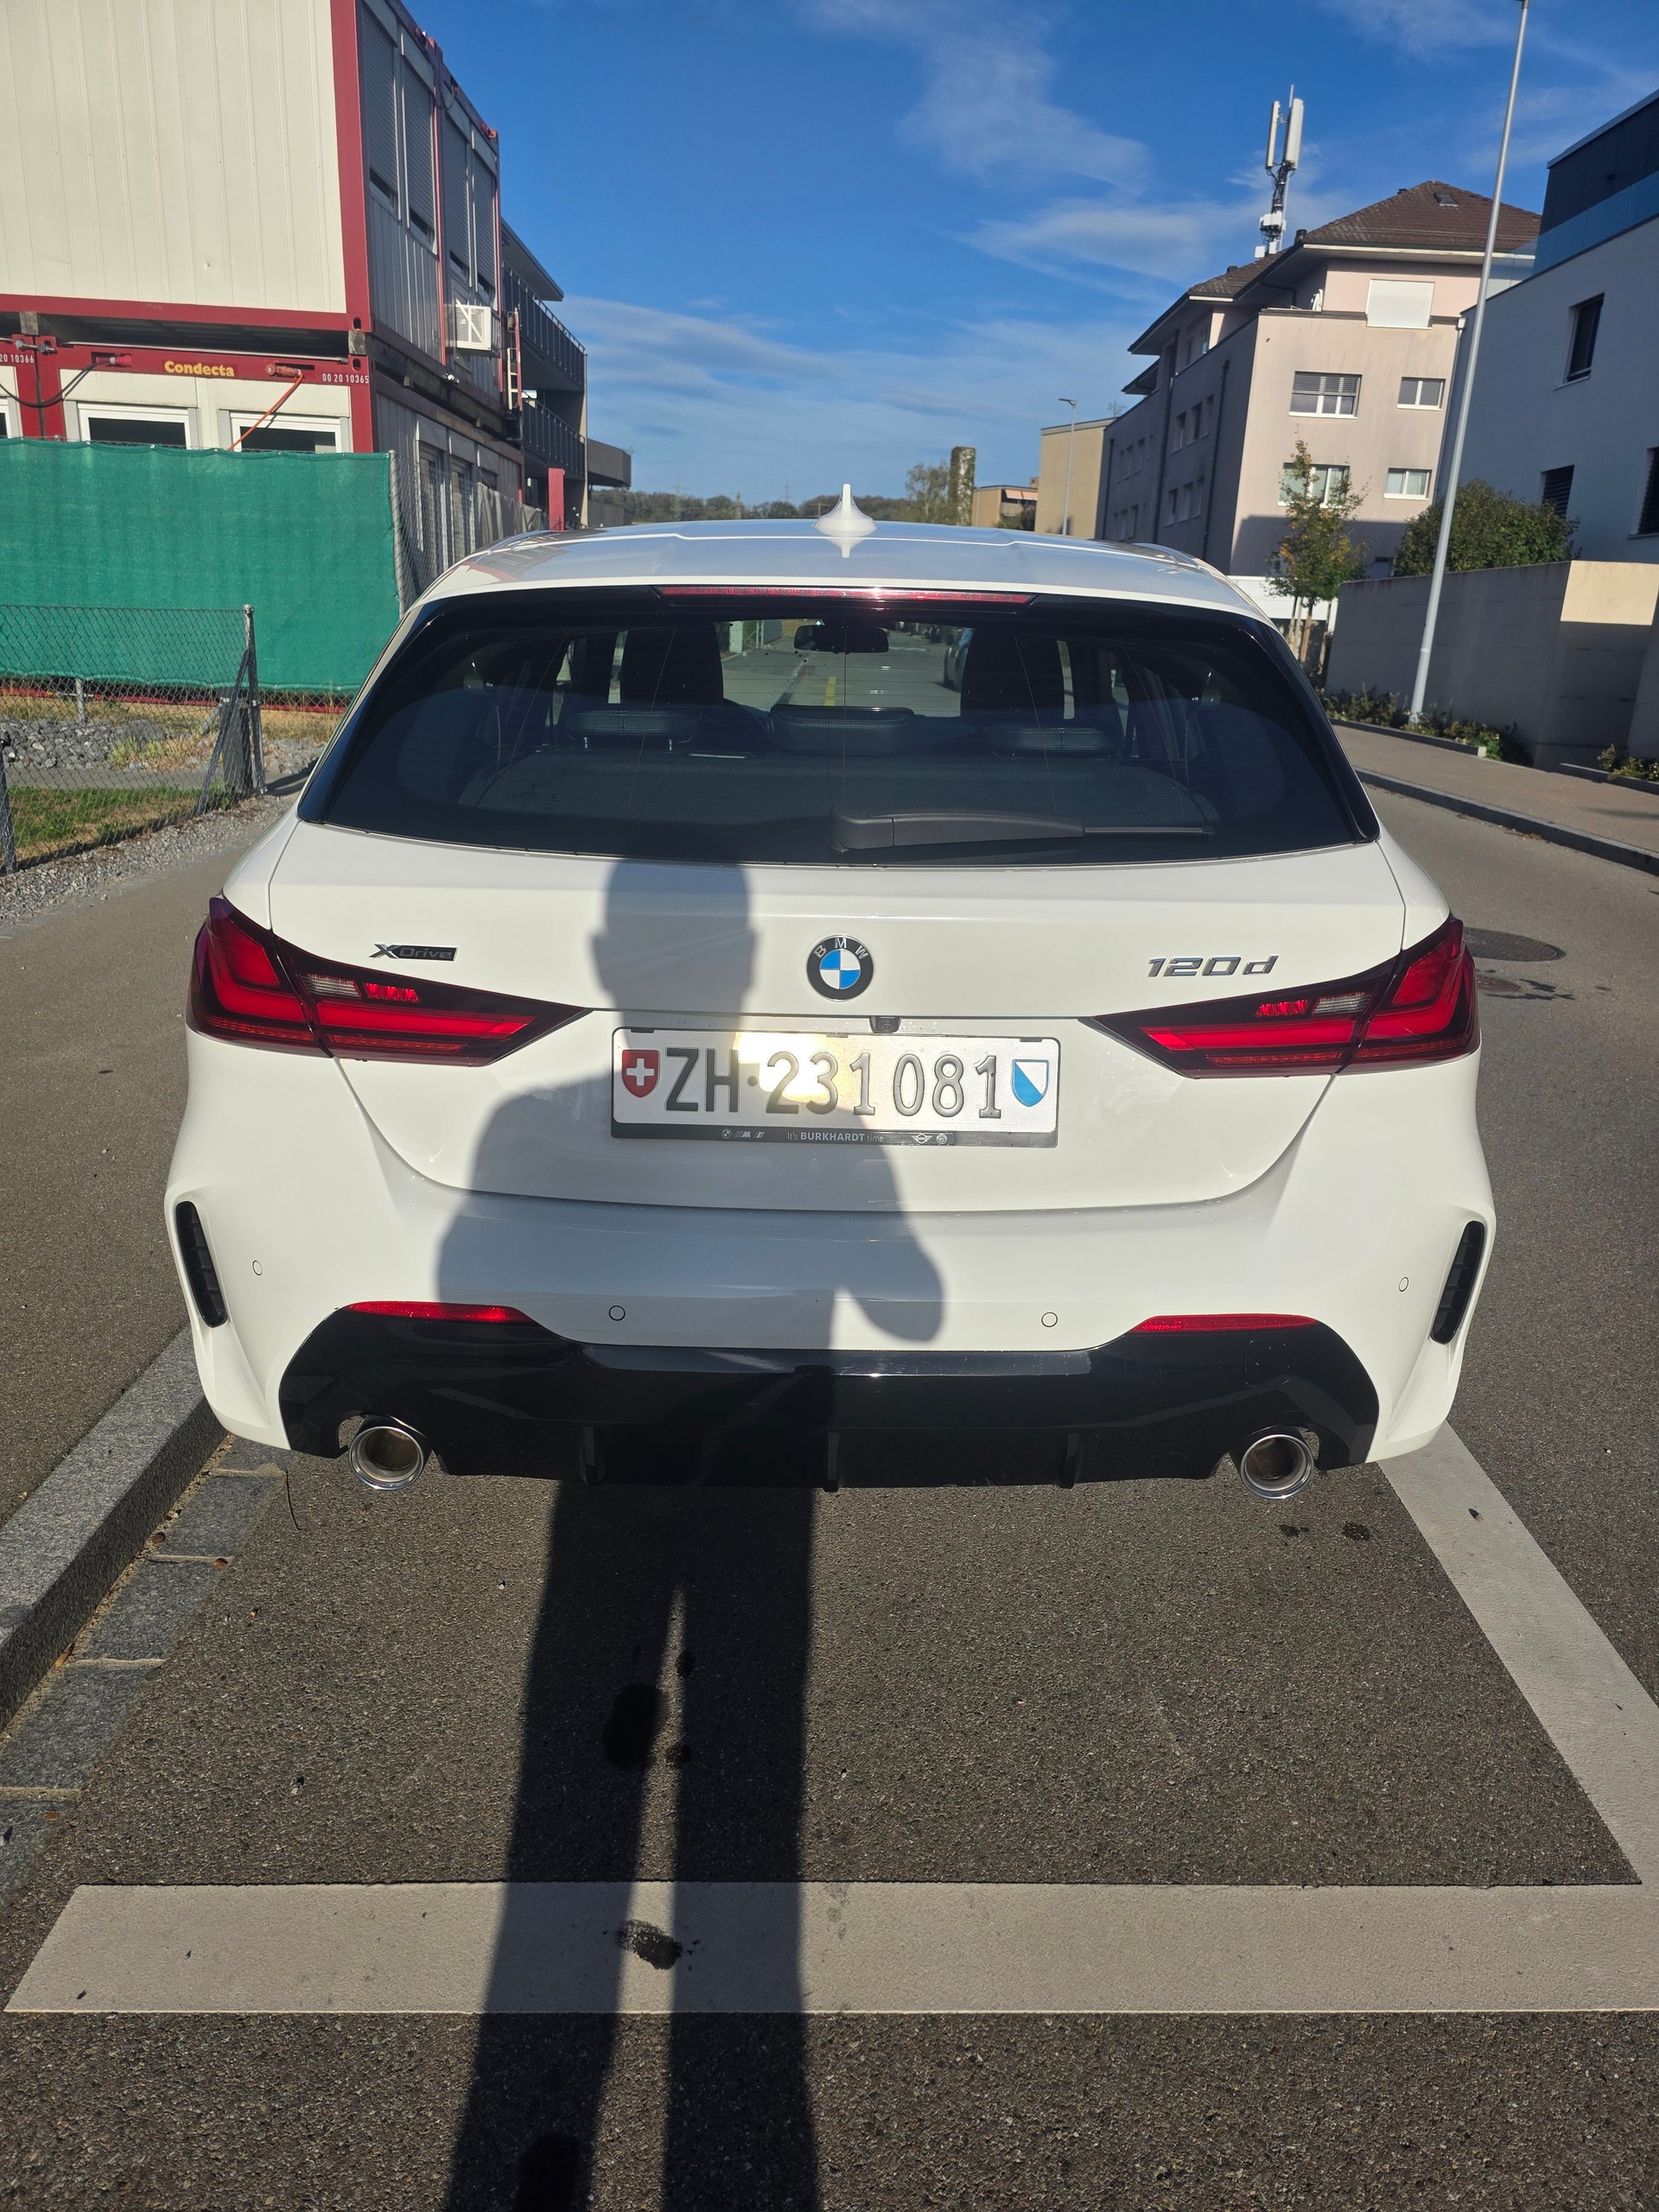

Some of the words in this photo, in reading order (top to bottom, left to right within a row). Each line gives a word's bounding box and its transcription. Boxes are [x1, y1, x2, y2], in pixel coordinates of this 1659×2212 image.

[10, 354, 35, 364] 10366
[164, 359, 235, 378] Condecta
[322, 373, 332, 382] 00
[334, 373, 343, 383] 20
[346, 374, 369, 384] 10365
[813, 938, 869, 959] BMW
[787, 1131, 798, 1141] It's
[800, 1132, 865, 1142] BURKHARDT
[867, 1134, 884, 1142] time
